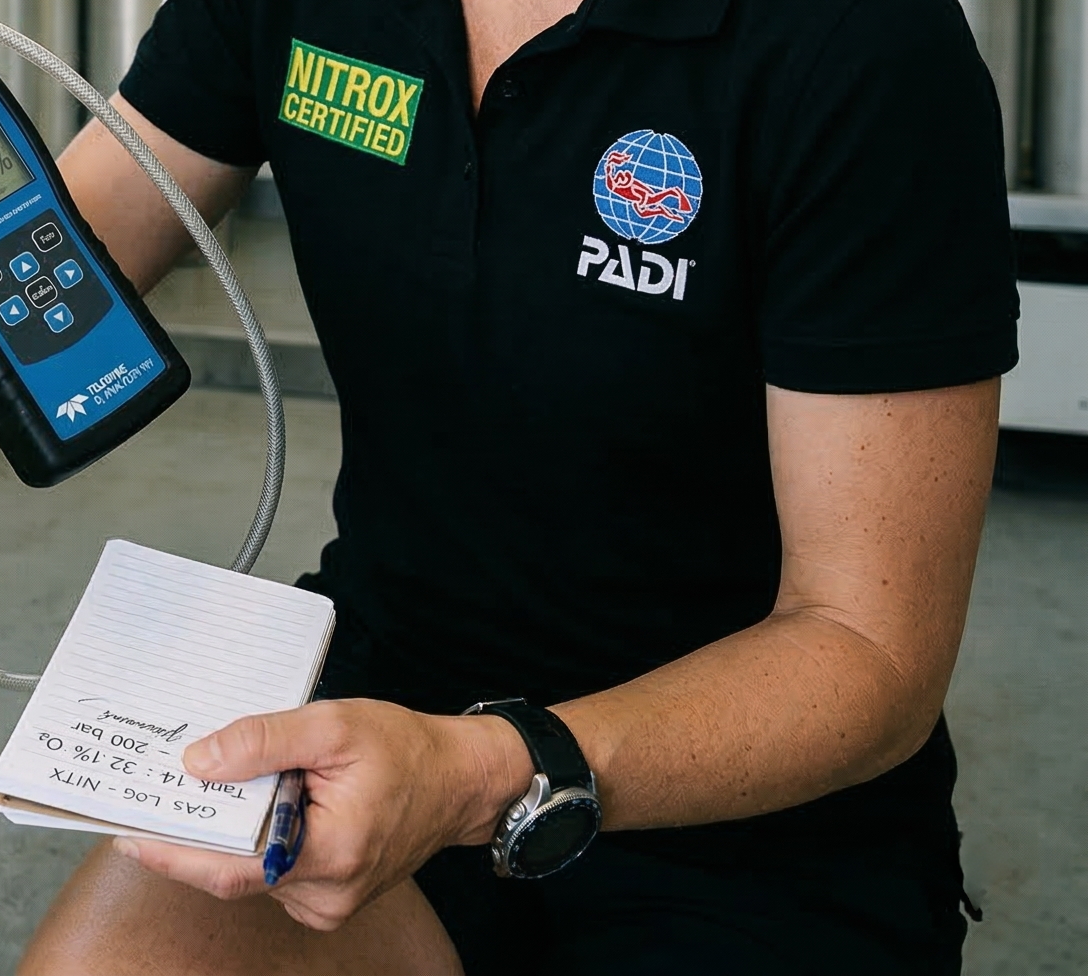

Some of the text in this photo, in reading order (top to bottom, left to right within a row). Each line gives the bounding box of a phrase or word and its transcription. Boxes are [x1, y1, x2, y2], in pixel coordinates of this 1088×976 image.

[287, 46, 418, 127] NITROX
[283, 94, 406, 158] CERTIFIED
[576, 235, 689, 301] PADI
[70, 721, 104, 740] bar
[110, 734, 149, 754] 200
[74, 744, 138, 775] 32.1%
[48, 767, 101, 792] NITX
[161, 771, 186, 787] 14
[198, 779, 247, 801] Tank
[123, 787, 161, 807] LOG
[173, 800, 217, 820] GAS
